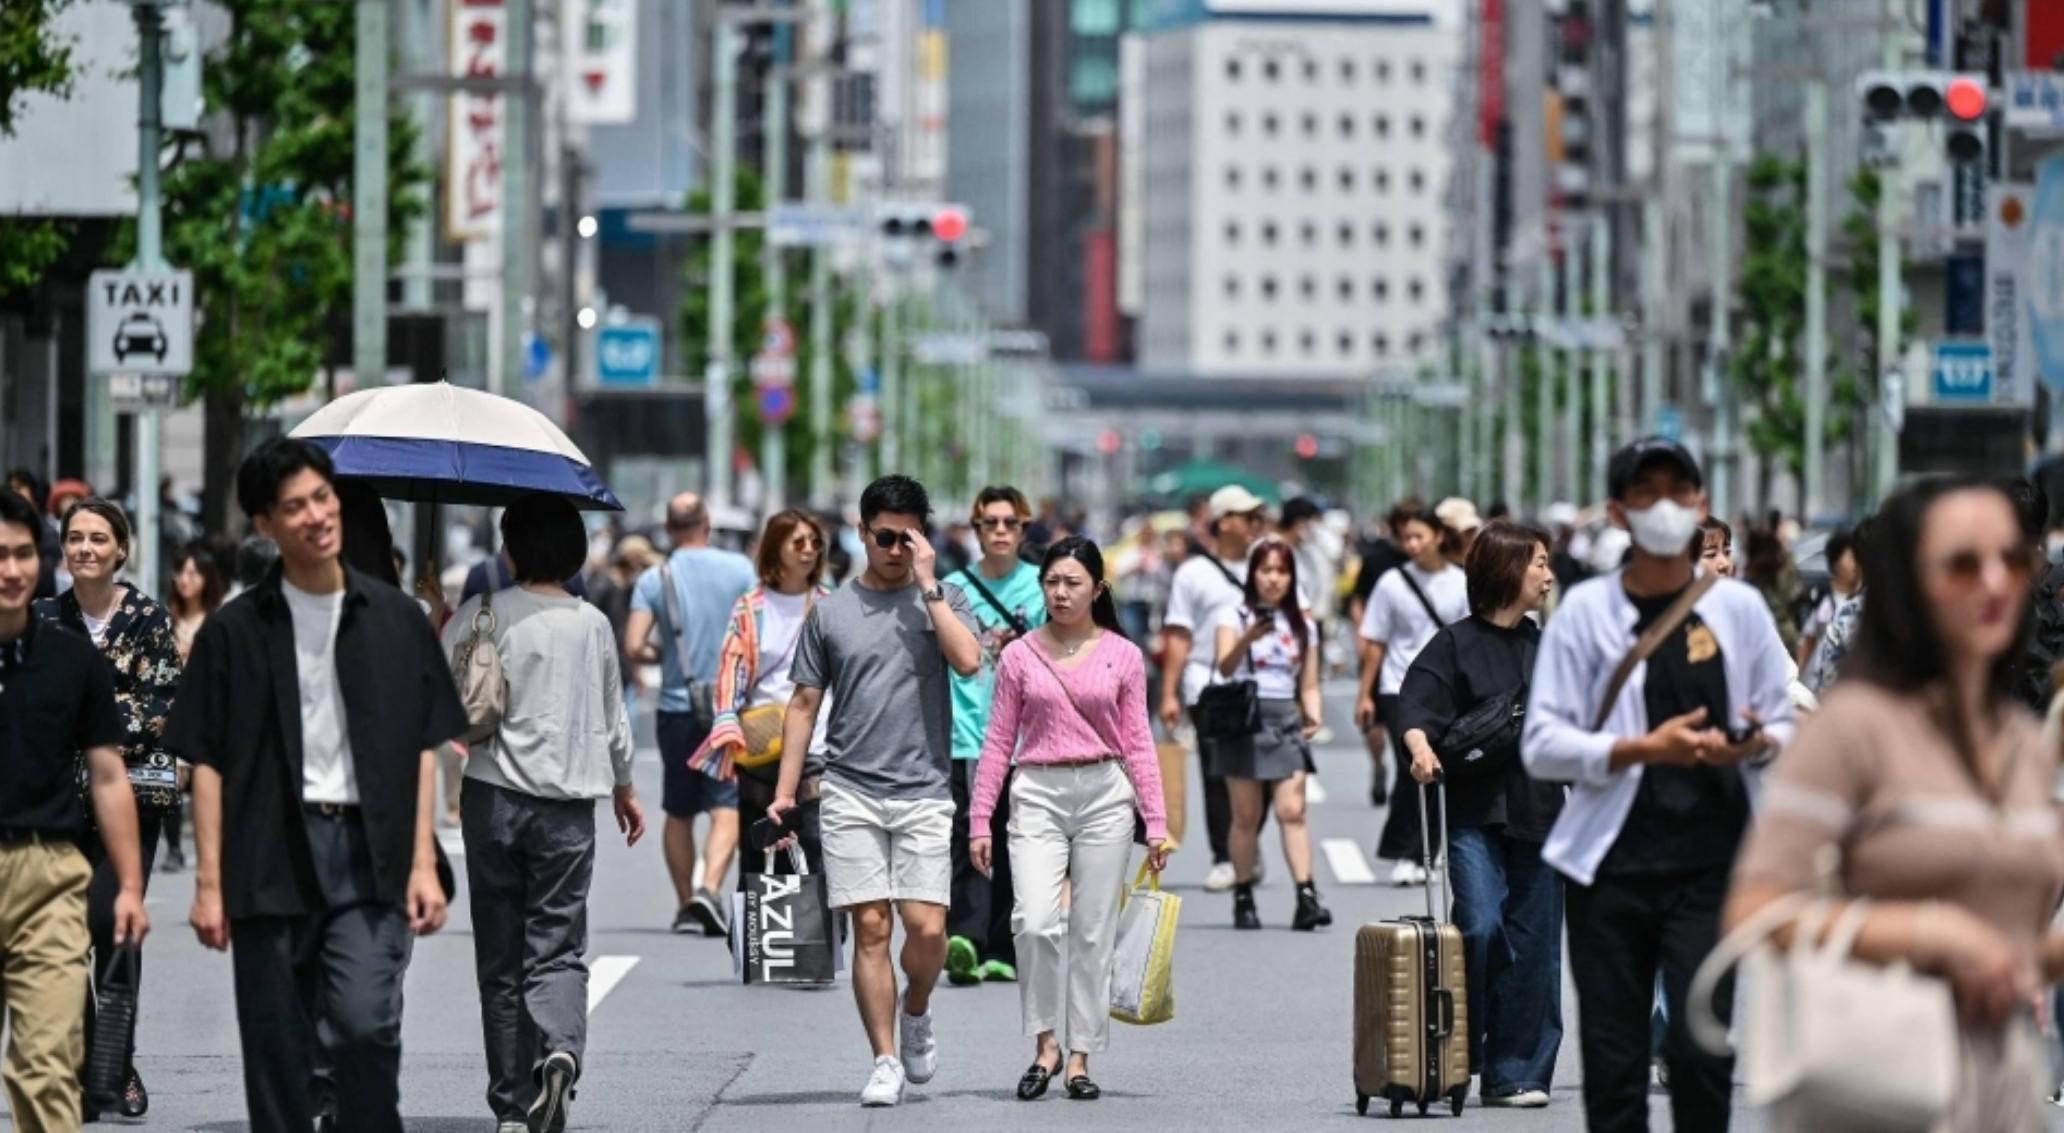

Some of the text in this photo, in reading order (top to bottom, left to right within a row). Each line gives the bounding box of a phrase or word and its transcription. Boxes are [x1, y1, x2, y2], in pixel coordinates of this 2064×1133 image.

[104, 282, 179, 306] TAXI
[747, 891, 758, 908] BY
[760, 874, 795, 983] AZUL
